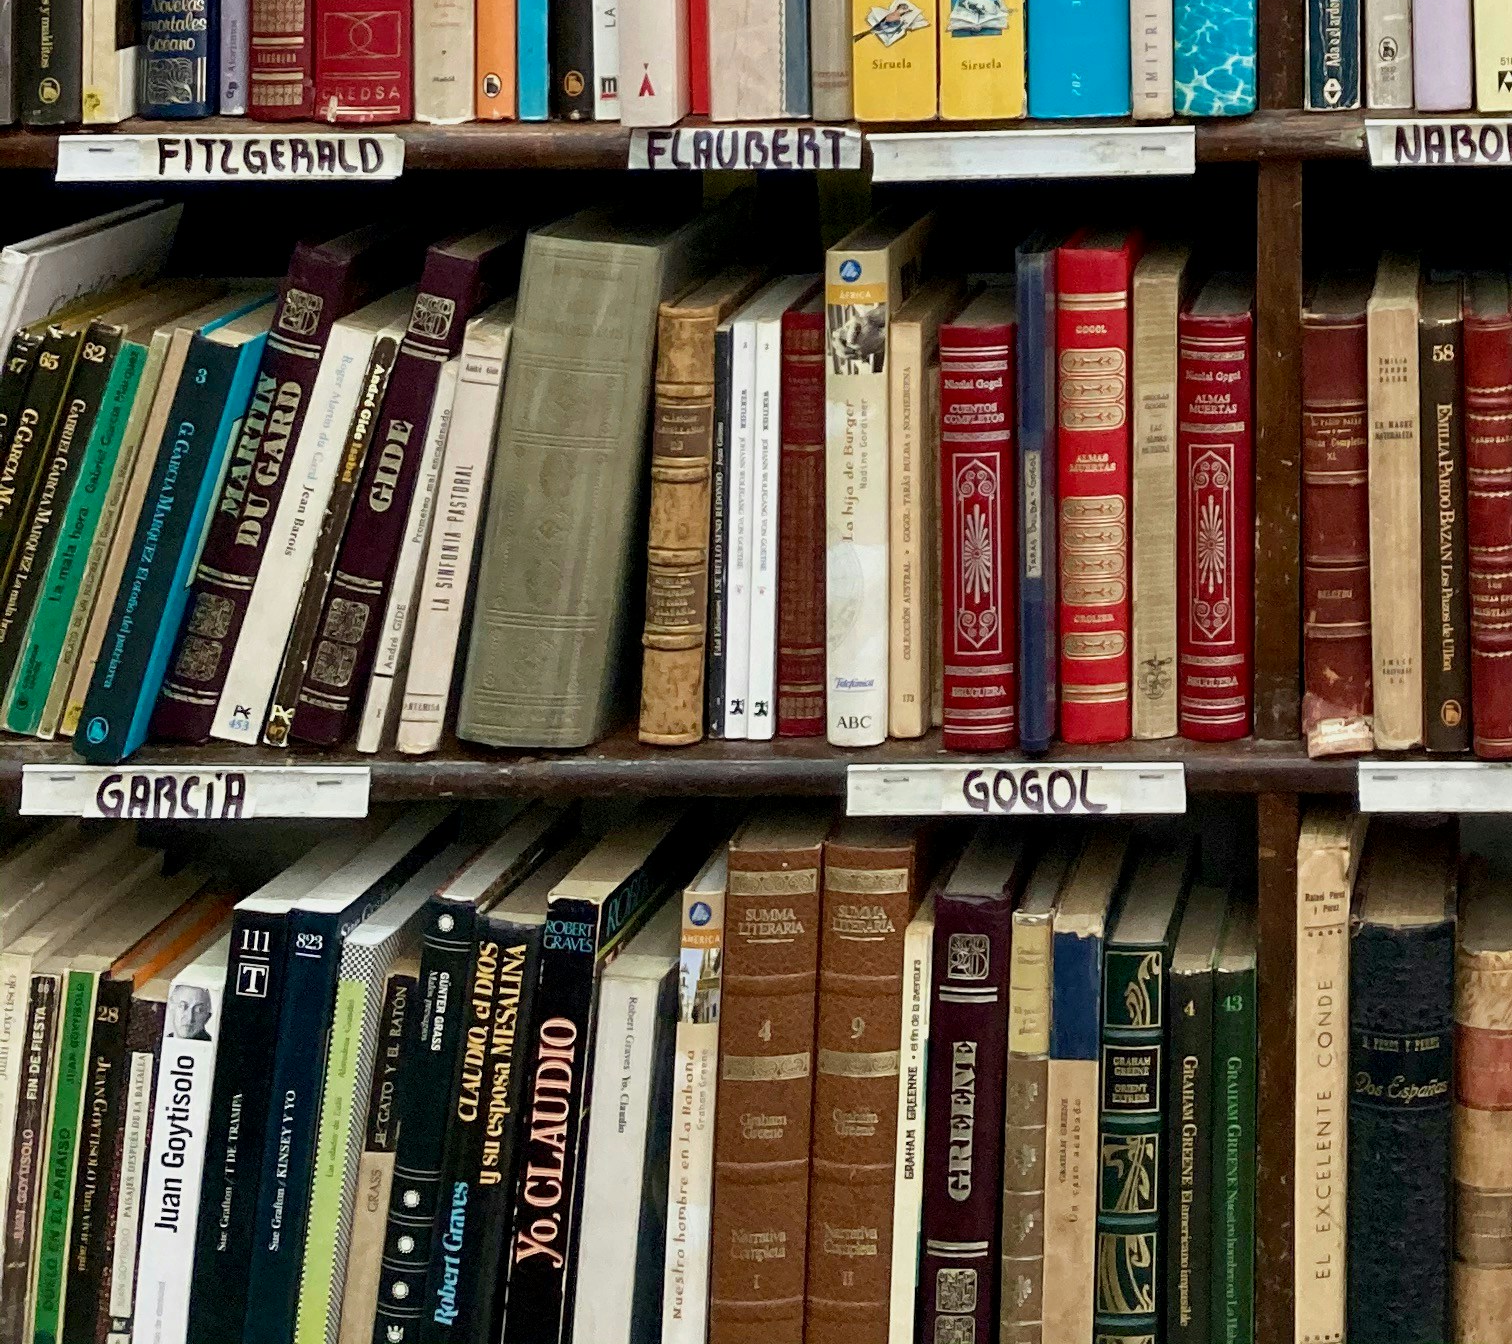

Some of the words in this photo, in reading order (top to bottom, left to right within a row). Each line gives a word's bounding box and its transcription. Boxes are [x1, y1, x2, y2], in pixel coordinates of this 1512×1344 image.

[872, 59, 911, 70] Siruela
[961, 59, 1001, 70] Siruela
[158, 136, 385, 174] FITZGERALD
[647, 128, 845, 169] FLAUBERT
[369, 418, 415, 512] GIDE
[447, 464, 474, 524] PASTORAL
[437, 530, 462, 590] SINFONIA
[431, 595, 450, 612] LA
[96, 773, 248, 817] GARCÍA
[963, 769, 1109, 811] GOGOL
[241, 929, 270, 951] 111
[296, 932, 323, 949] 823
[543, 919, 593, 936] ROBERT
[543, 934, 594, 953] GRAVES
[244, 967, 263, 994] T
[473, 939, 500, 997] DIOS
[471, 999, 492, 1020] el
[490, 943, 528, 1057] MESALINA
[1317, 979, 1335, 1068] CONDE
[458, 1025, 490, 1122] CLAUDIO,
[161, 1055, 196, 1168] Goytisolo
[486, 1062, 511, 1138] esposa
[524, 1017, 578, 1207] CLAUDIO
[949, 1040, 977, 1202] GREENE
[479, 1170, 502, 1186] y
[482, 1140, 501, 1167] su
[1316, 1089, 1333, 1233] EXCELENTE
[154, 1177, 182, 1233] Juan
[441, 1180, 470, 1252] Graves
[516, 1209, 564, 1269] Yo,
[433, 1254, 461, 1326] Robert
[1316, 1253, 1332, 1280] EL
